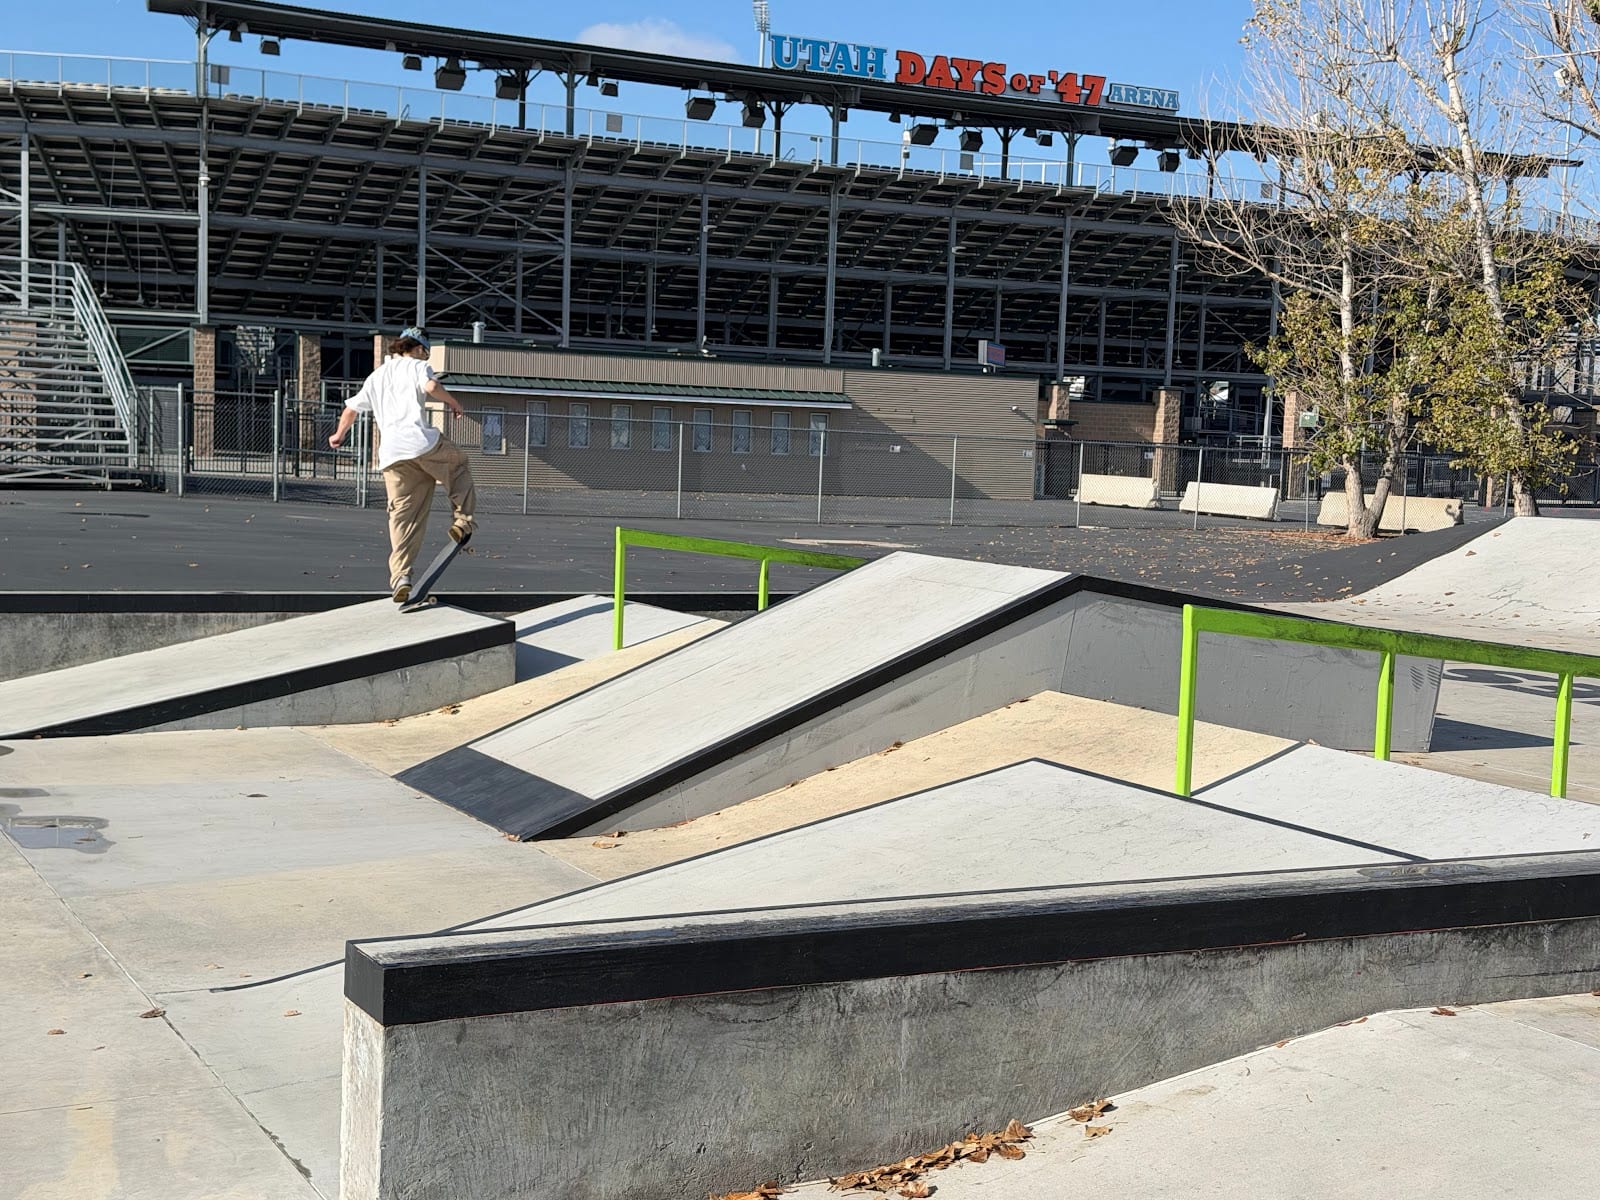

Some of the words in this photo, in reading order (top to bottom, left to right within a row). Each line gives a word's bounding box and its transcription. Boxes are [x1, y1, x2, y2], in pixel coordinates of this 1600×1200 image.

[770, 35, 888, 79] UTAH
[896, 50, 1006, 95] DAYS
[1048, 70, 1106, 106] '47
[1109, 85, 1178, 109] ARENA
